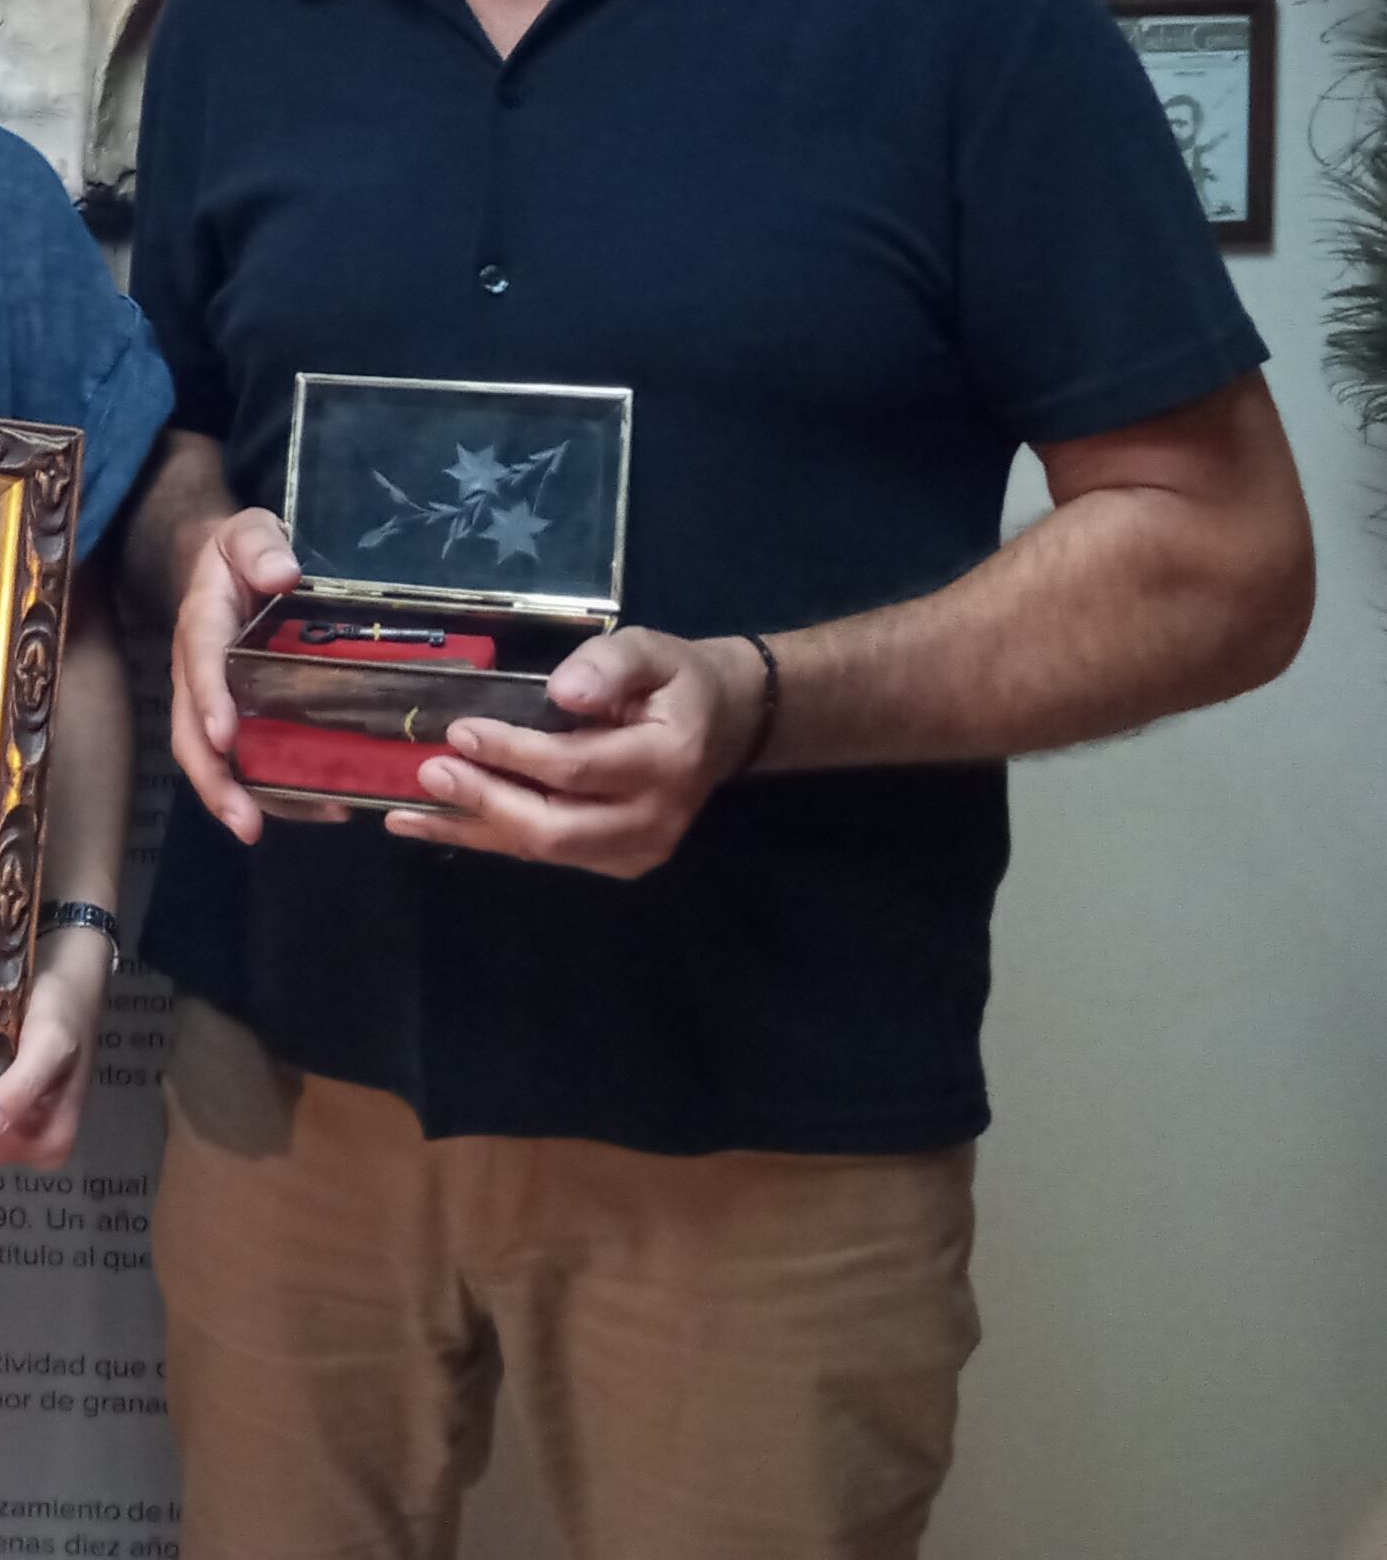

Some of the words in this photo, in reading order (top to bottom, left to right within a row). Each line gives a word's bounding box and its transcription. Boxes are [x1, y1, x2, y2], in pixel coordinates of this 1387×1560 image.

[15, 1175, 72, 1194] tuvo
[83, 1175, 147, 1201] igual
[46, 1207, 84, 1230] Un
[73, 1245, 94, 1267] al
[95, 1359, 146, 1380] que
[40, 1391, 74, 1412] de
[128, 1500, 162, 1523] de
[64, 1534, 119, 1557] diez
